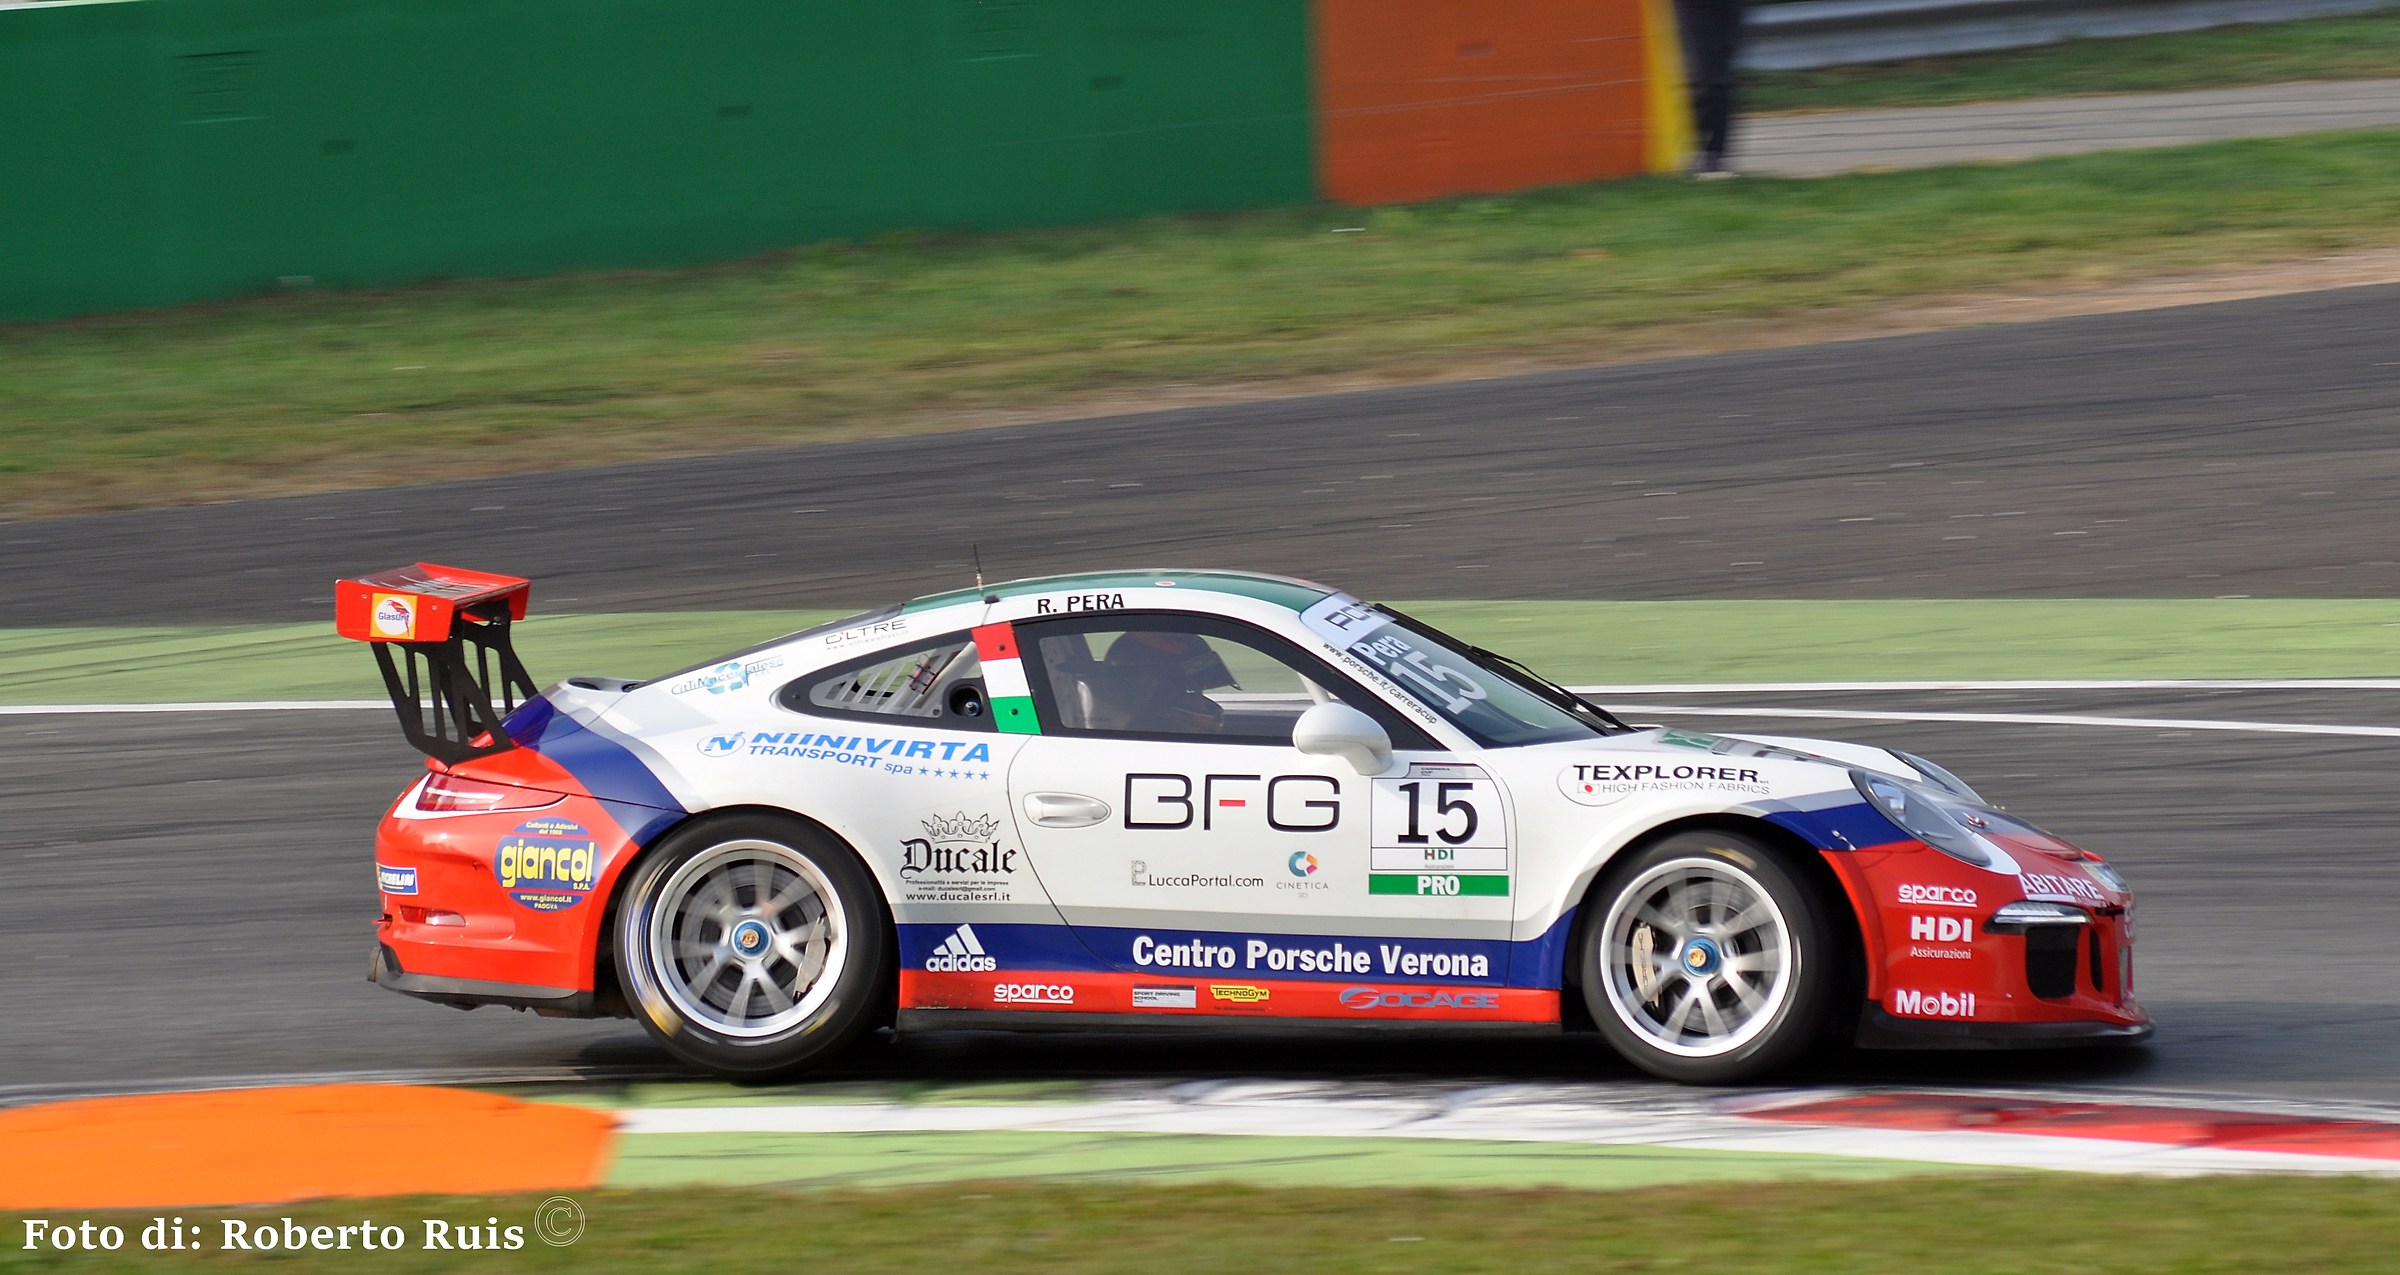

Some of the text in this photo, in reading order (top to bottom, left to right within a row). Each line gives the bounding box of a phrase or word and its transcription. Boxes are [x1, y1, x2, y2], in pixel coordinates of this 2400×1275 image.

[1037, 593, 1125, 614] R. PERA
[1350, 634, 1413, 666] Pera
[1322, 641, 1438, 725] www.porsche.it/carreracup
[1389, 650, 1487, 715] 15
[749, 745, 913, 775] TRANSPORT spa
[751, 732, 990, 763] NIINIVIRTA
[1572, 764, 1759, 784] TEXPLORER
[1602, 781, 1770, 795] HIGH FASHION FABRICS
[1123, 772, 1341, 833] BFG
[1397, 781, 1479, 846] 15
[500, 838, 596, 888] giancol
[899, 838, 1018, 880] Ducale
[1424, 849, 1454, 860] HDI
[1149, 873, 1264, 888] LuccaPortal.com
[1276, 882, 1329, 890] CINETICA
[1417, 875, 1461, 896] PRO
[2018, 872, 2106, 900] ABITARE
[520, 894, 572, 904] www.giancol.it
[905, 892, 1011, 901] www.ducalesrl.it
[1898, 883, 1978, 906] sparco
[1910, 915, 1973, 943] HDI
[925, 953, 997, 972] adidas
[1132, 935, 1489, 977] Centro Porsche Verona
[1910, 946, 1972, 960] Assicurazioni
[993, 983, 1074, 1002] sparco
[1895, 989, 1976, 1017] Mobil
